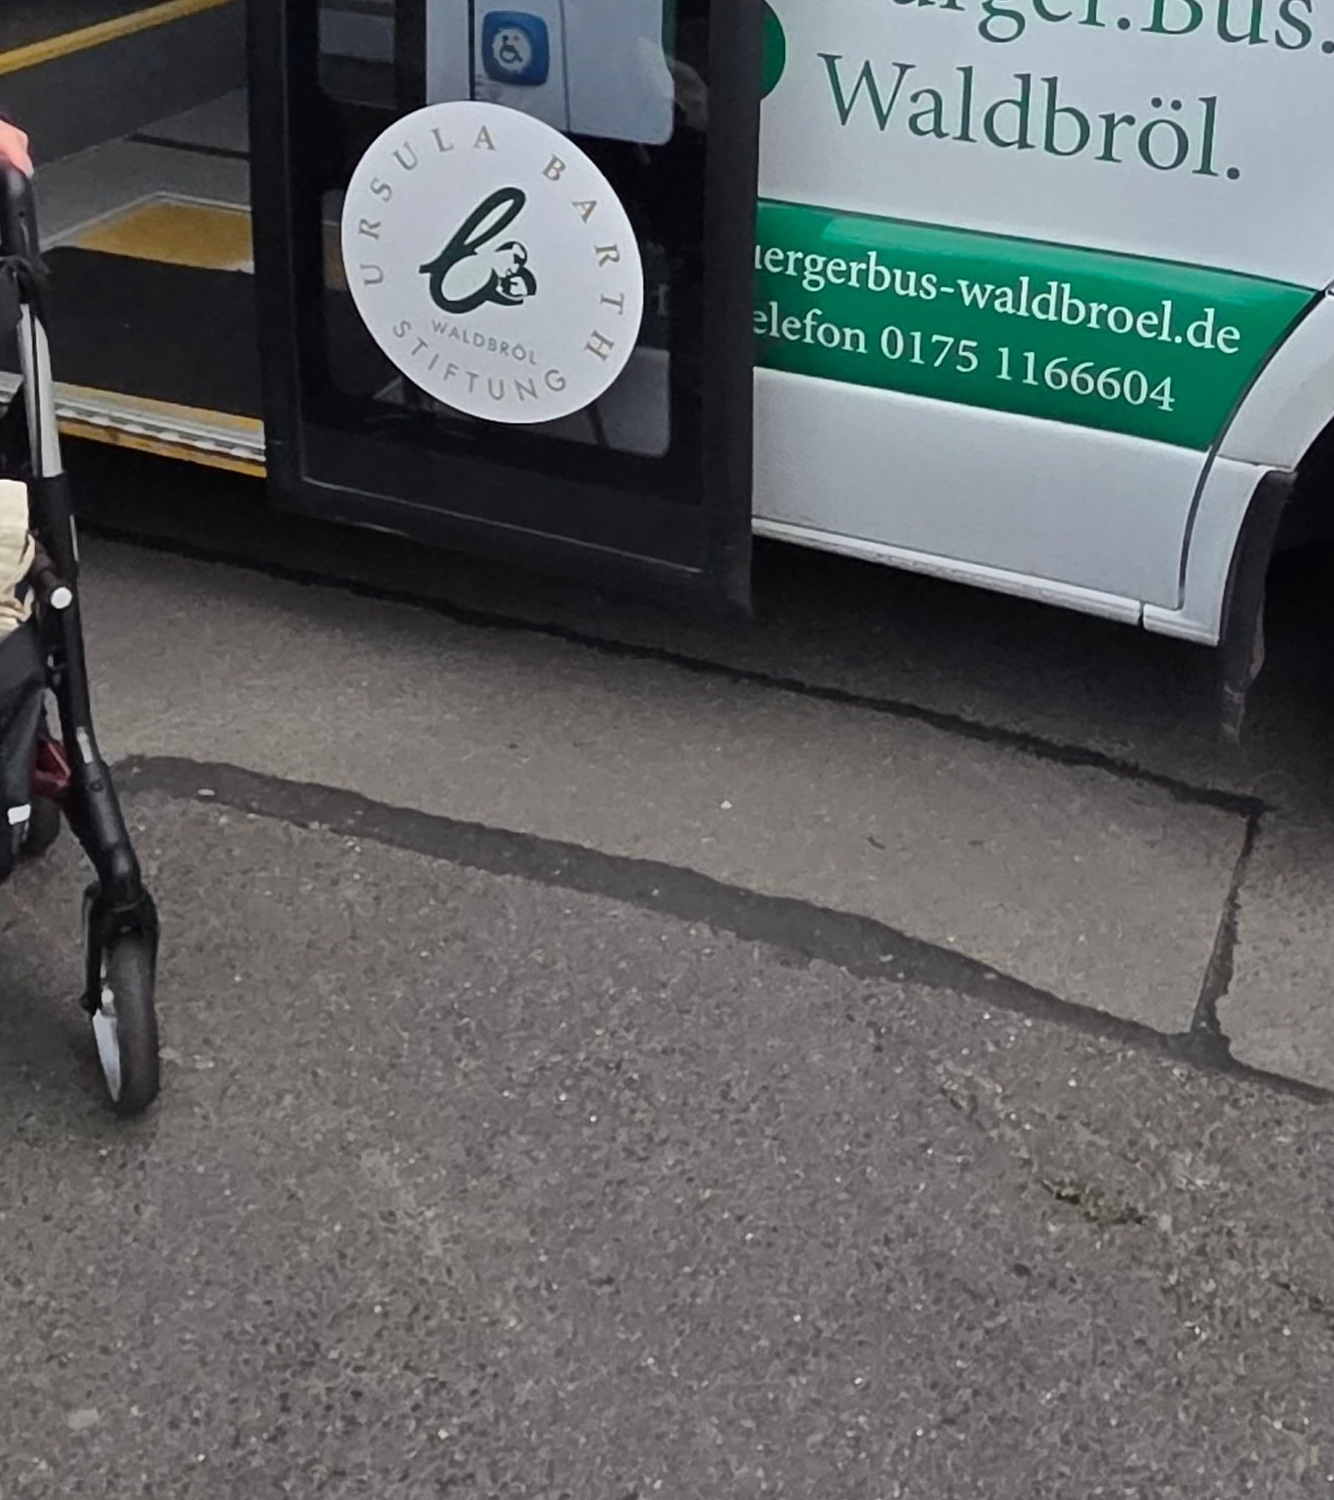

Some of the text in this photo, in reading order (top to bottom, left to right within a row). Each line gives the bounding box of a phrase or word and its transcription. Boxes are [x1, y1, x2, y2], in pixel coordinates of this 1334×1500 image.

[817, 52, 1241, 181] Waldbröl.
[358, 124, 625, 363] URSULA BARTH
[393, 320, 567, 401] STIFTUNG
[880, 326, 979, 374] 0175
[996, 346, 1176, 412] 1166604
